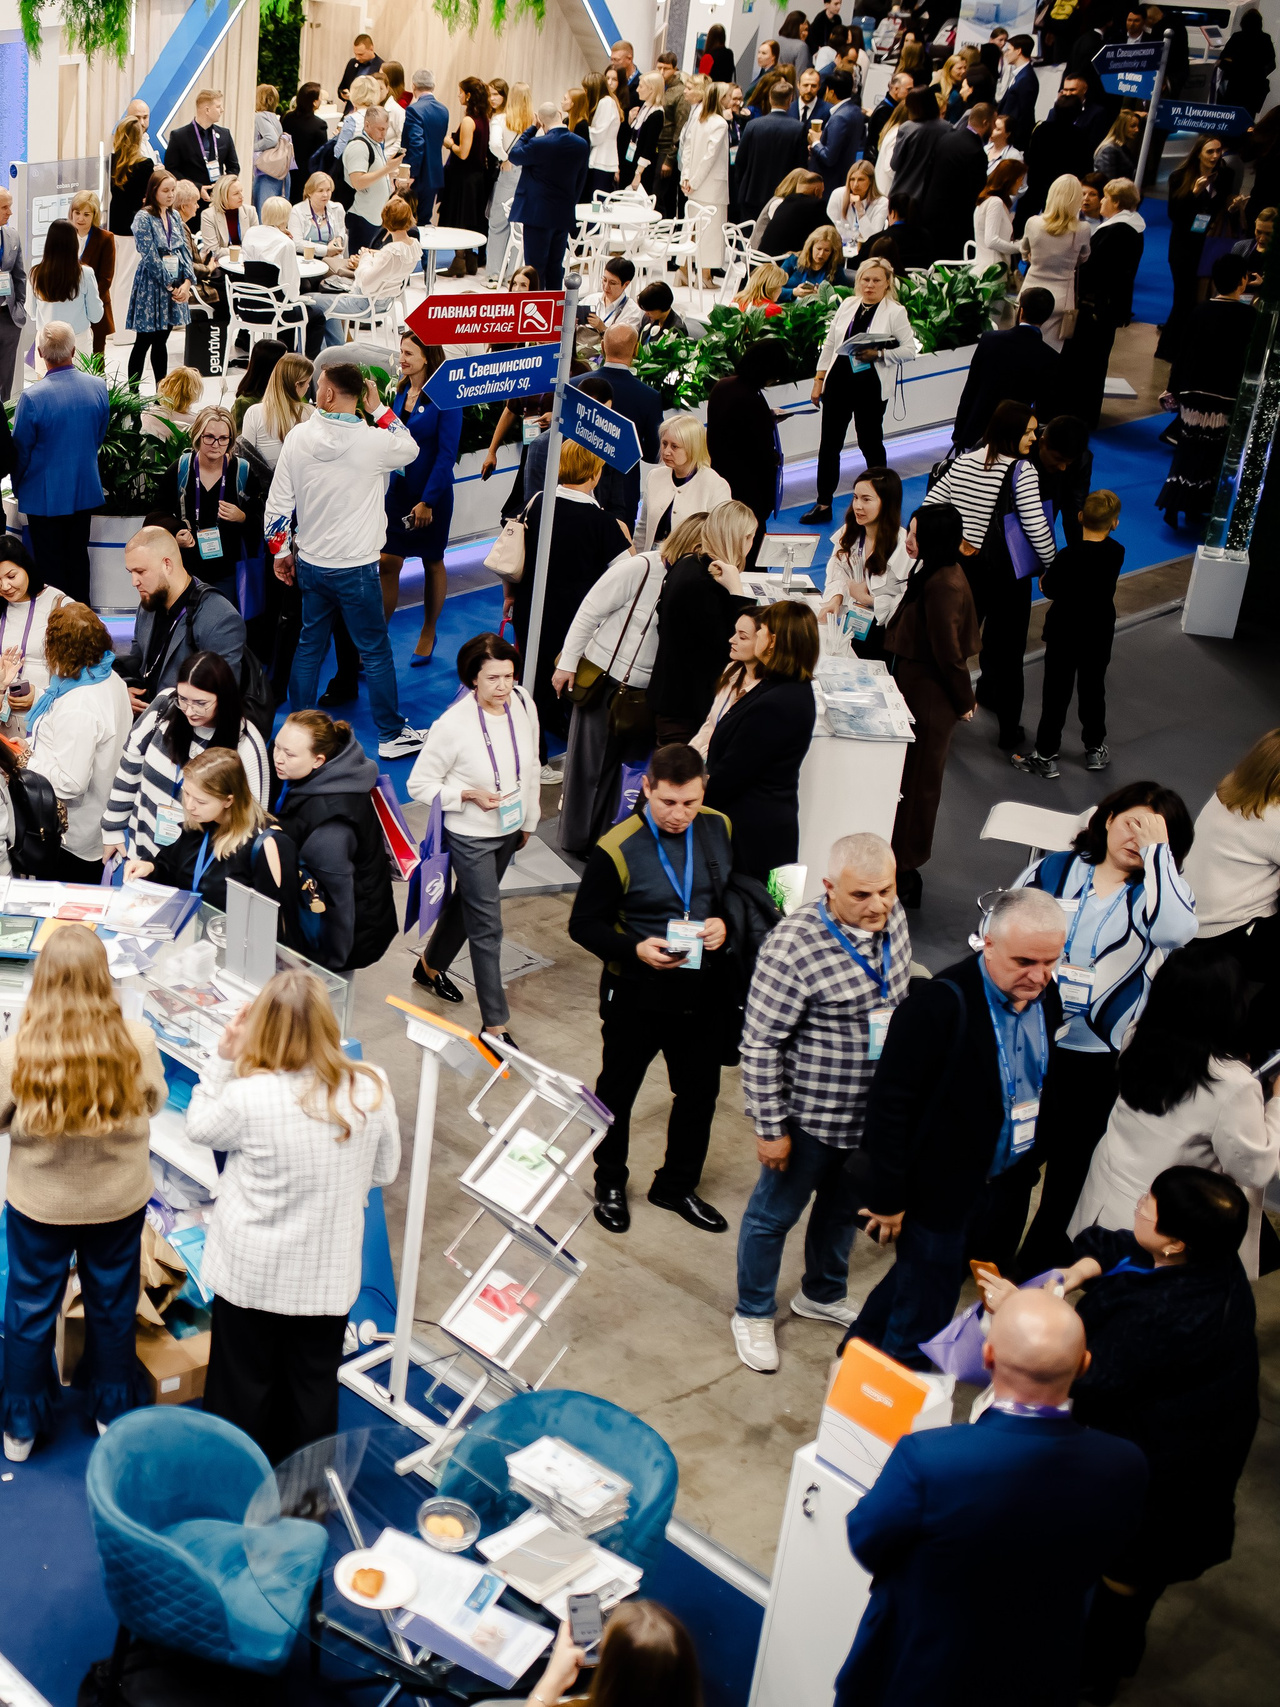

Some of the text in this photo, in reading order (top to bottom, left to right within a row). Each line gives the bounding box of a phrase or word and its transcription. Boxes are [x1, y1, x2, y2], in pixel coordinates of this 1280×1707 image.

[1171, 106, 1236, 120] ул. Циклинской
[1173, 117, 1216, 130] Tsiklinskaya
[428, 304, 515, 319] ГЛАВНАЯ СЦЕНА
[455, 322, 515, 334] MAIN STAGE
[449, 356, 543, 382] пл. Свещинского
[456, 377, 531, 399] Sveschinsky sq.
[576, 402, 621, 440] пр-т Гамалеи
[575, 420, 616, 458] Gamaleya ave.
